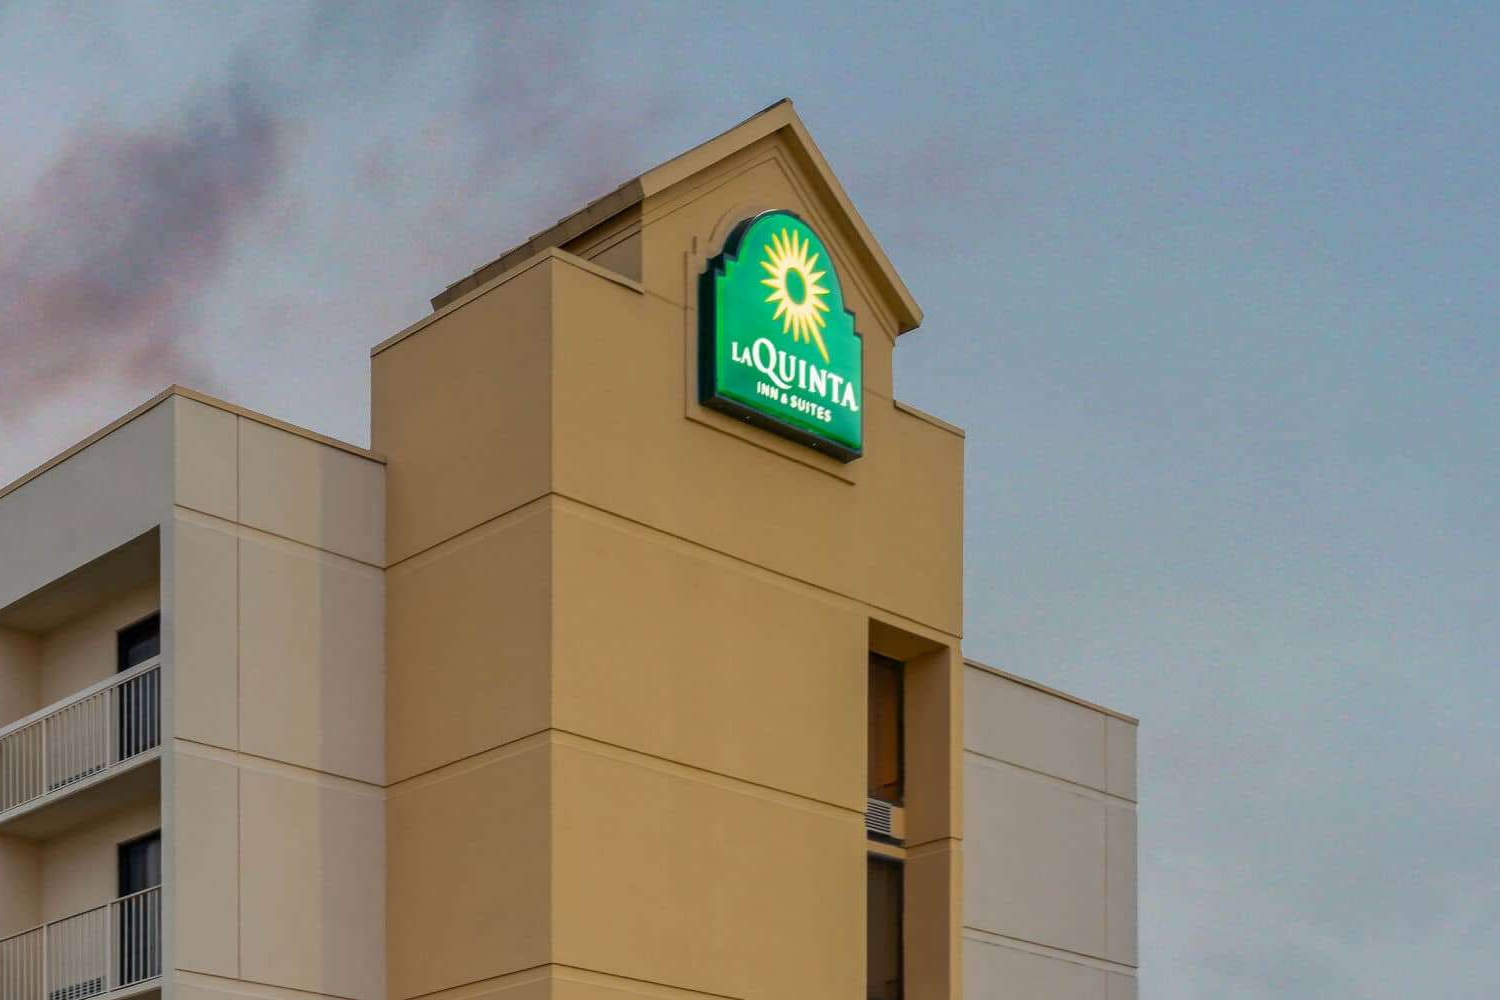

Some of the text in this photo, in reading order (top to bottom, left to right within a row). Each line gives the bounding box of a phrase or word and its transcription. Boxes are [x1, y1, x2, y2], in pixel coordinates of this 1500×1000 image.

[752, 337, 859, 412] QUINTA
[756, 381, 832, 423] INN & SUITES
